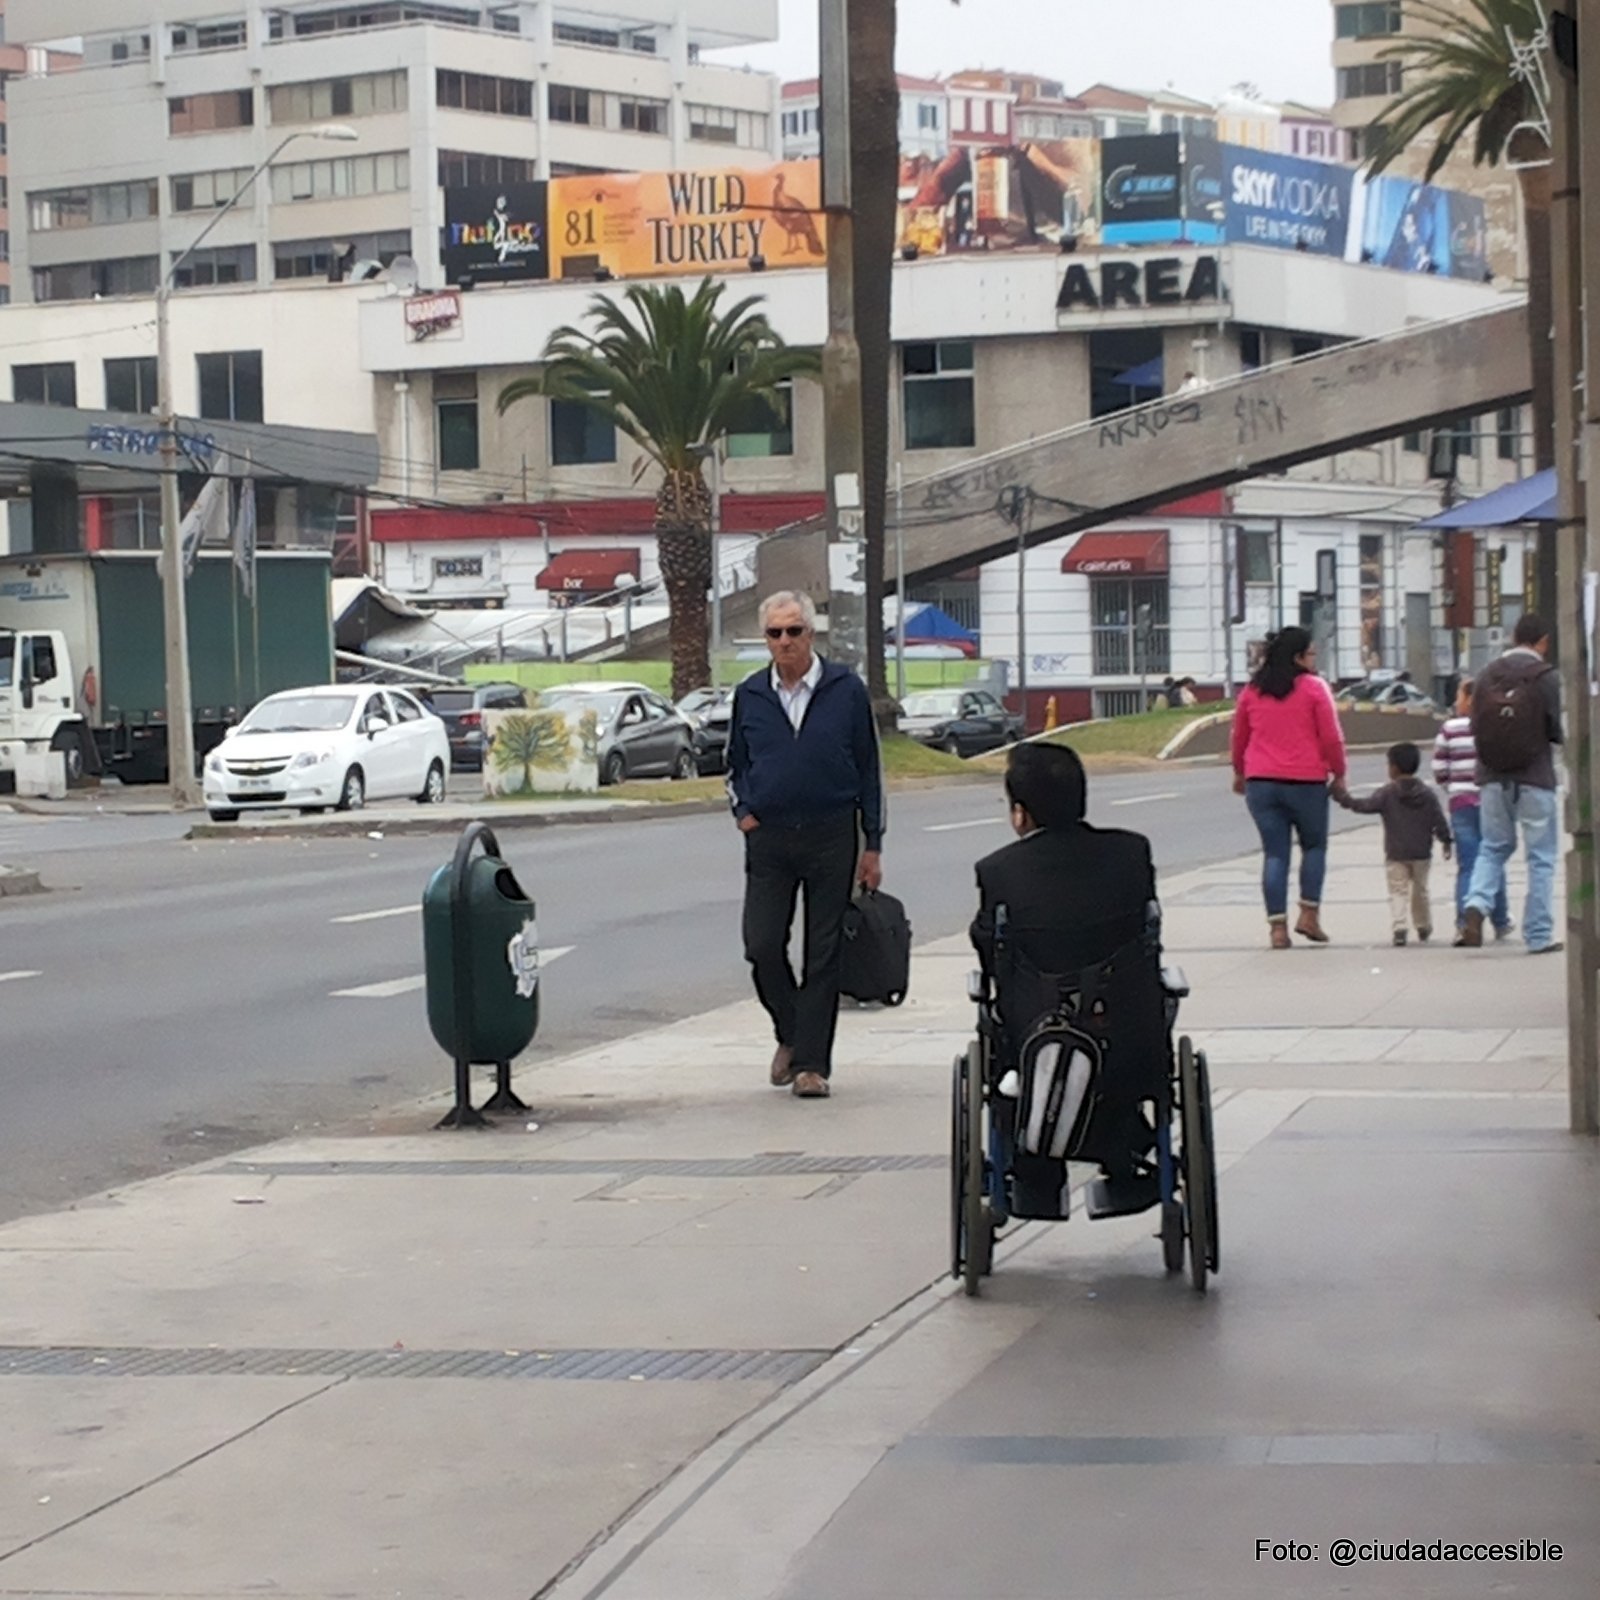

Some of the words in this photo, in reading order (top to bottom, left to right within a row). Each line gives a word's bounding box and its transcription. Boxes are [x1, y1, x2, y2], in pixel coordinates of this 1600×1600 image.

[667, 172, 746, 217] WILD
[1277, 176, 1341, 220] VODKA
[565, 209, 596, 247] 81
[646, 217, 766, 264] TURKEY
[1055, 255, 1231, 309] AREA
